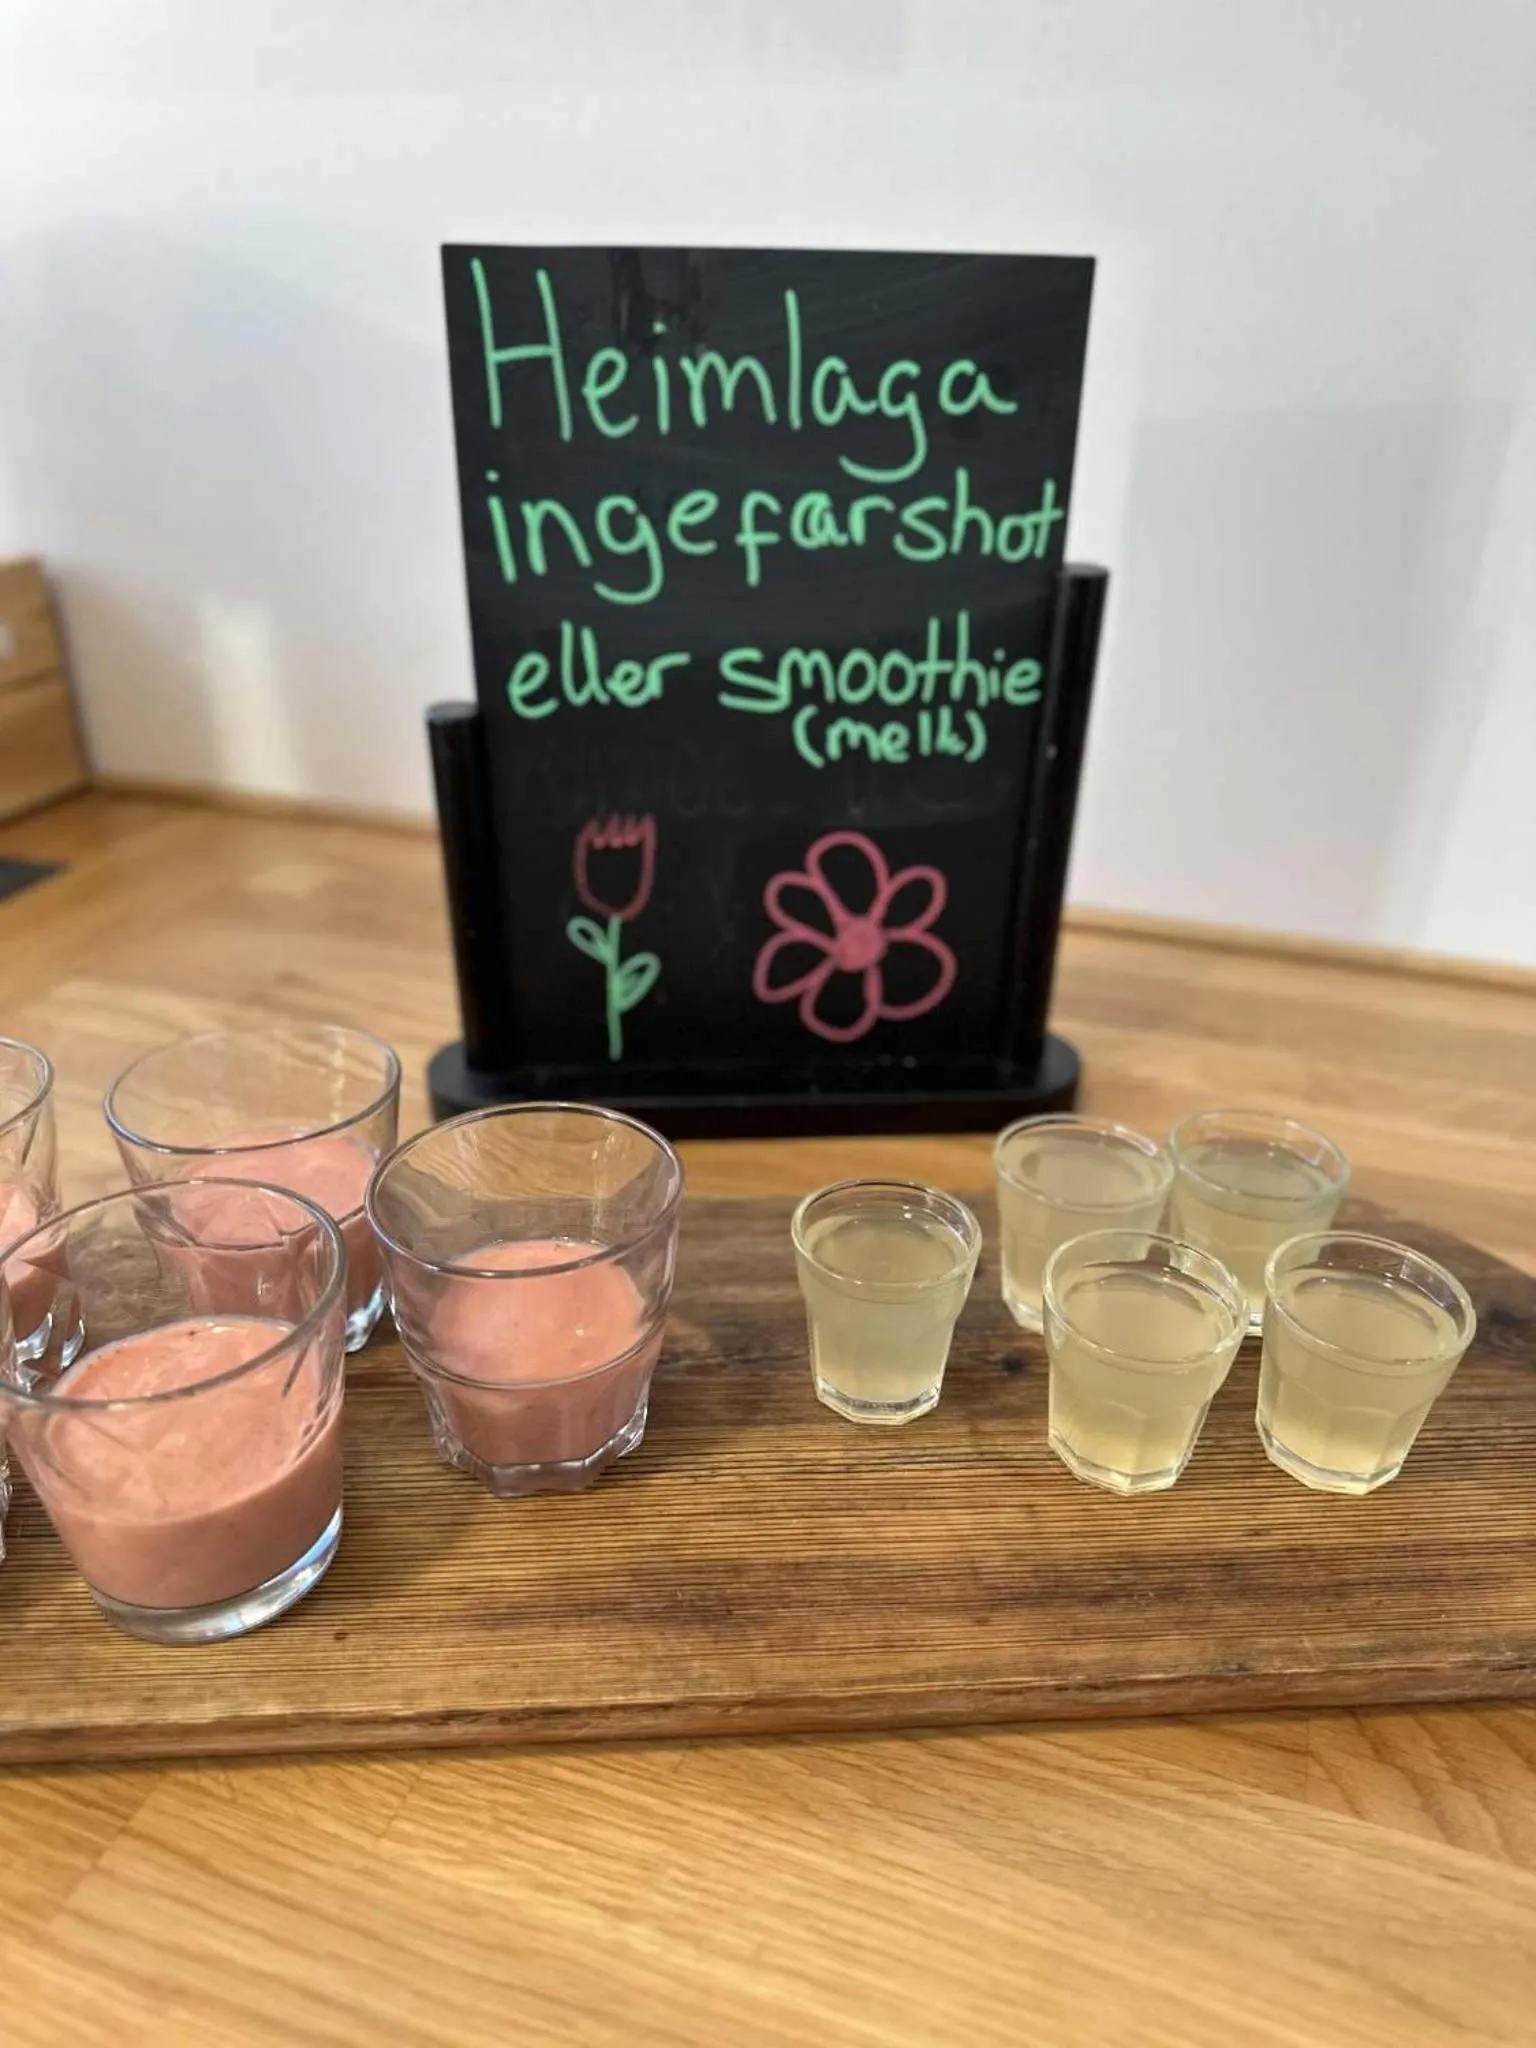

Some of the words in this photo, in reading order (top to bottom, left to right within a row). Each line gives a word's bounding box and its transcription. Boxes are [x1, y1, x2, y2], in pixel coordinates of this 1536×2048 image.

[470, 257, 1018, 482] Heimlaga
[485, 467, 1066, 606] ingefarshot
[507, 620, 690, 719] eller
[719, 609, 1042, 714] smoothie
